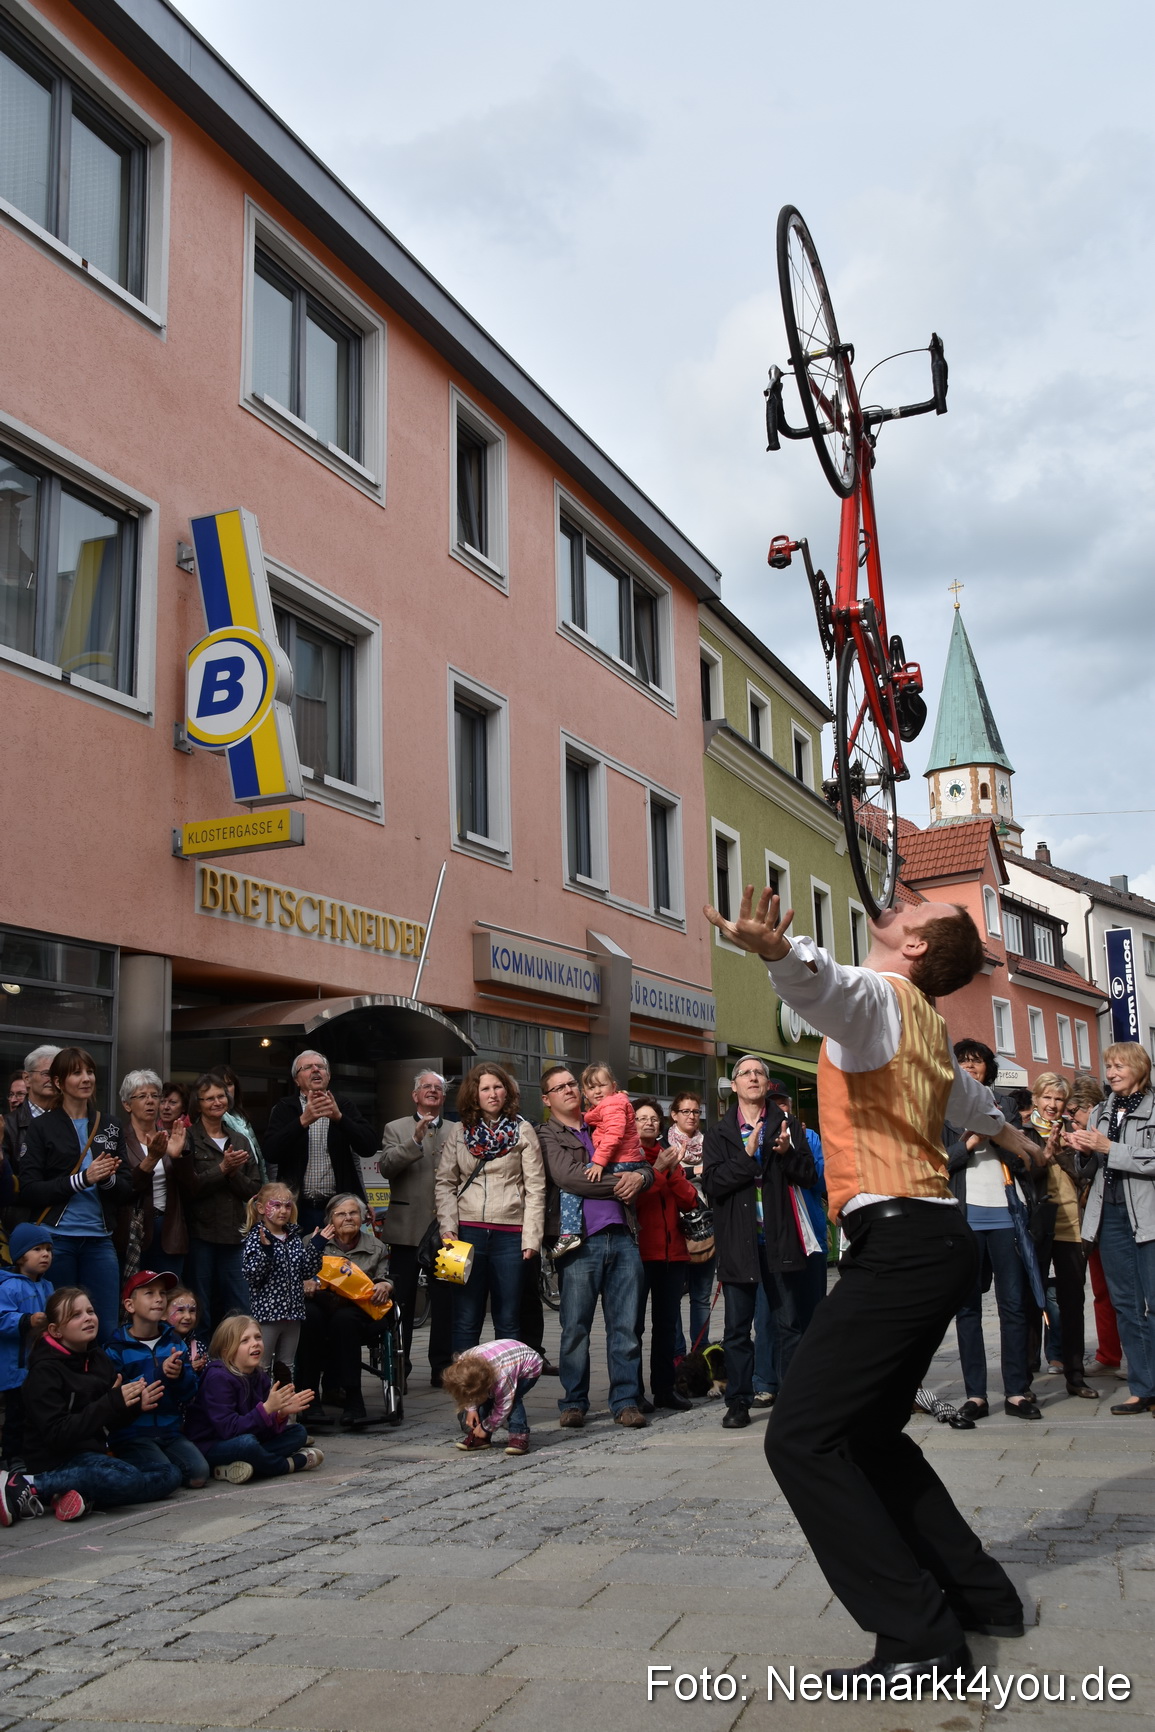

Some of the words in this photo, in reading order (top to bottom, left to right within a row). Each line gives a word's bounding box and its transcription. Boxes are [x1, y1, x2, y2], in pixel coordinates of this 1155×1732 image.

[196, 656, 245, 718] B
[188, 820, 273, 844] KLOSTERGASSE
[277, 819, 284, 831] 4
[201, 867, 430, 959] BRETSCHNEIDER
[491, 945, 600, 994] KOMMUNIKATION
[1123, 939, 1134, 993] TAILOR
[1127, 995, 1137, 1035] TOM
